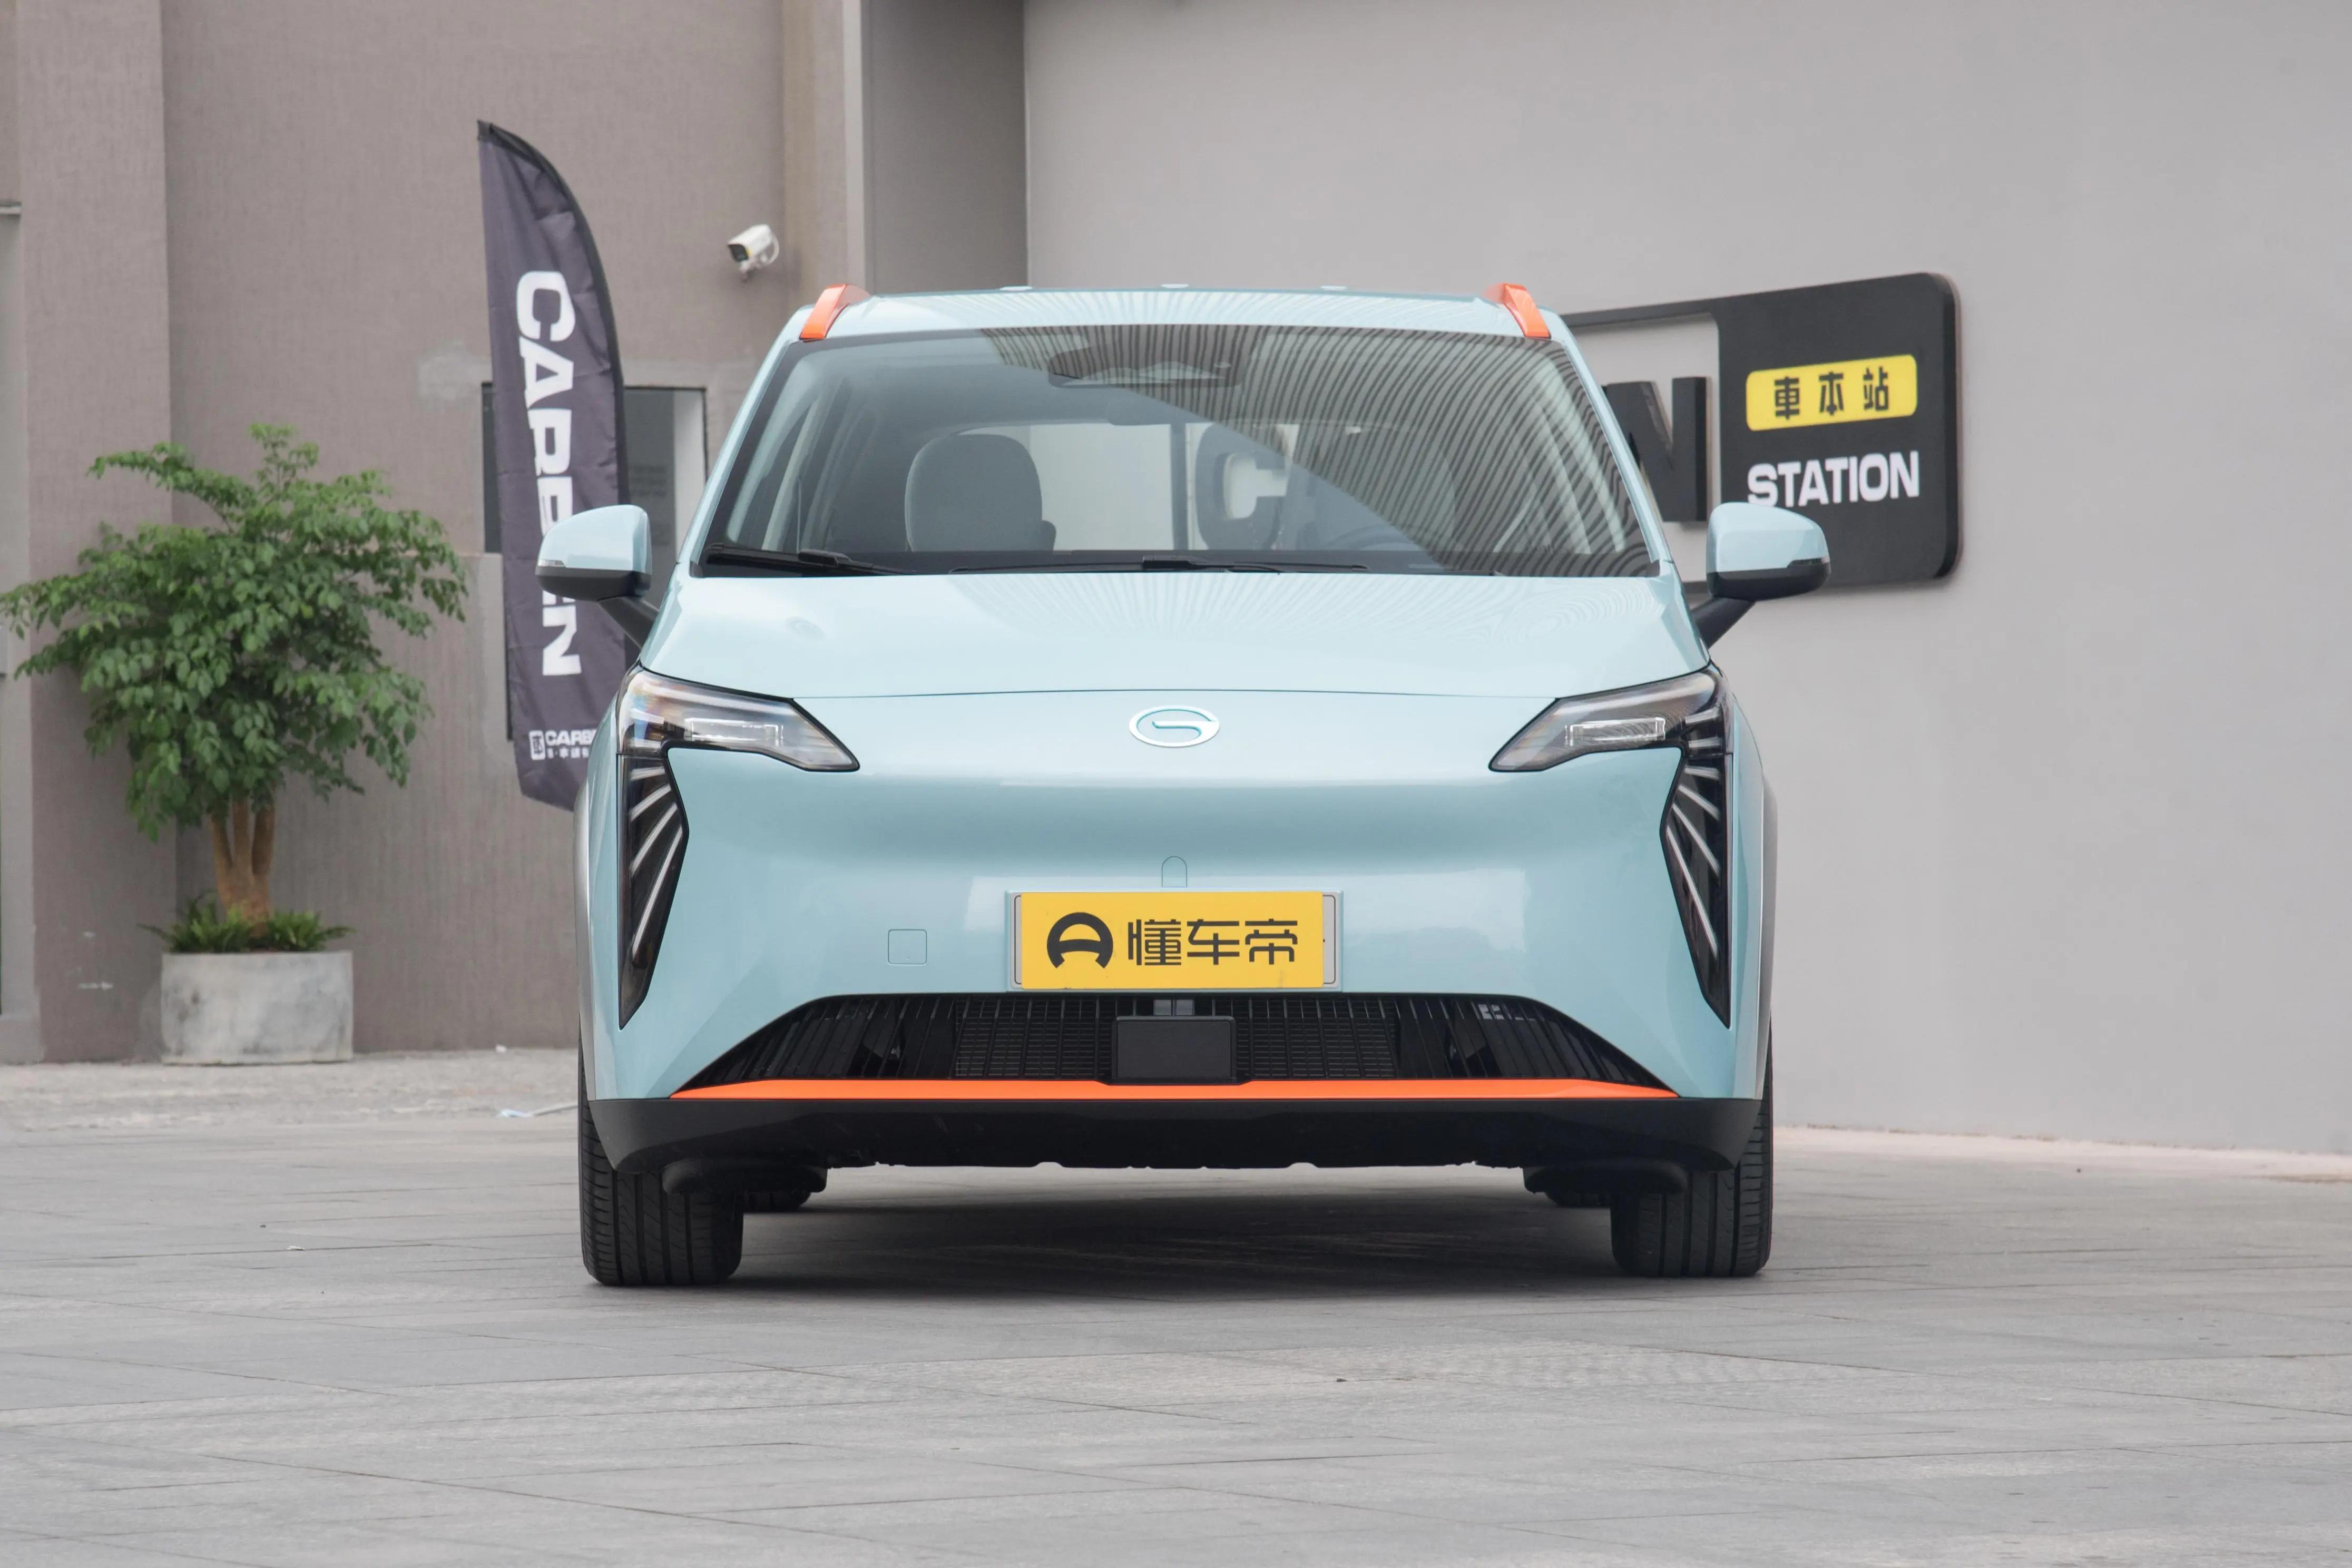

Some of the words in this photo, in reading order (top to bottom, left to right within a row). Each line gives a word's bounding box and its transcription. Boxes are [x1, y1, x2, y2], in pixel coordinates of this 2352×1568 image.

[1774, 366, 1889, 420] 車本站
[516, 270, 582, 676] CARBN
[1747, 450, 1920, 508] STATION
[545, 729, 596, 746] CARB
[1128, 918, 1298, 966] 懂车帝
